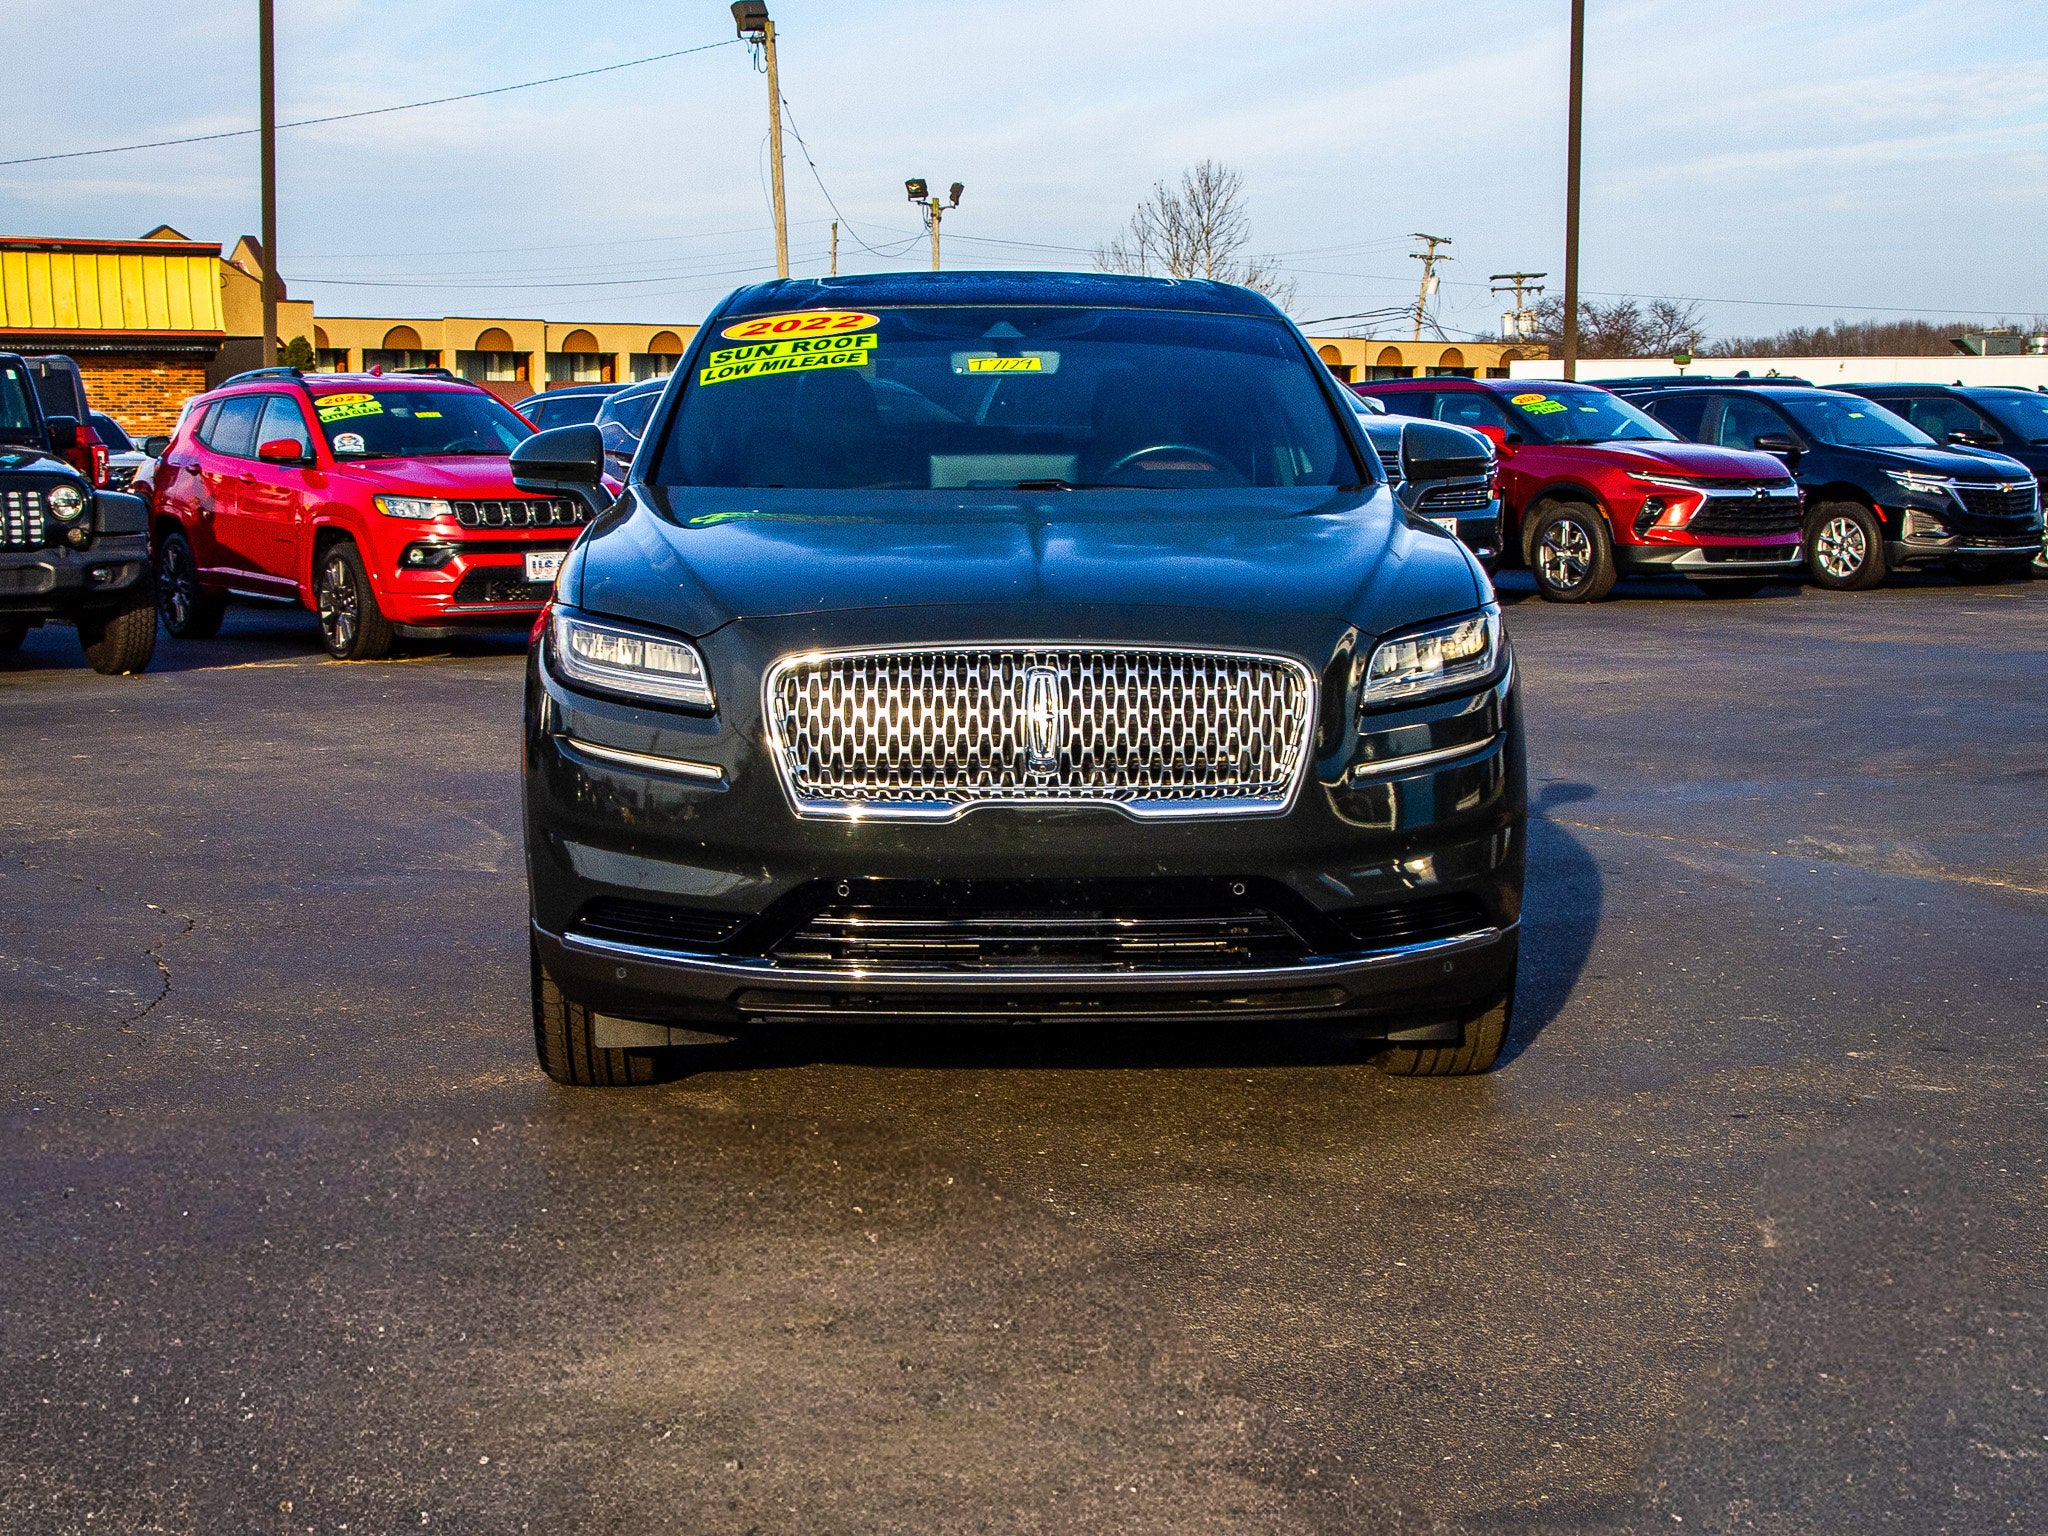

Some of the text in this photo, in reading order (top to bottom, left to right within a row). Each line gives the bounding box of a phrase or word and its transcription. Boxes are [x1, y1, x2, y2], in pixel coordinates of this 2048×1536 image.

[739, 314, 865, 337] 2022
[713, 335, 872, 364] SUN ROOF
[704, 352, 863, 382] LOW MILEAGE
